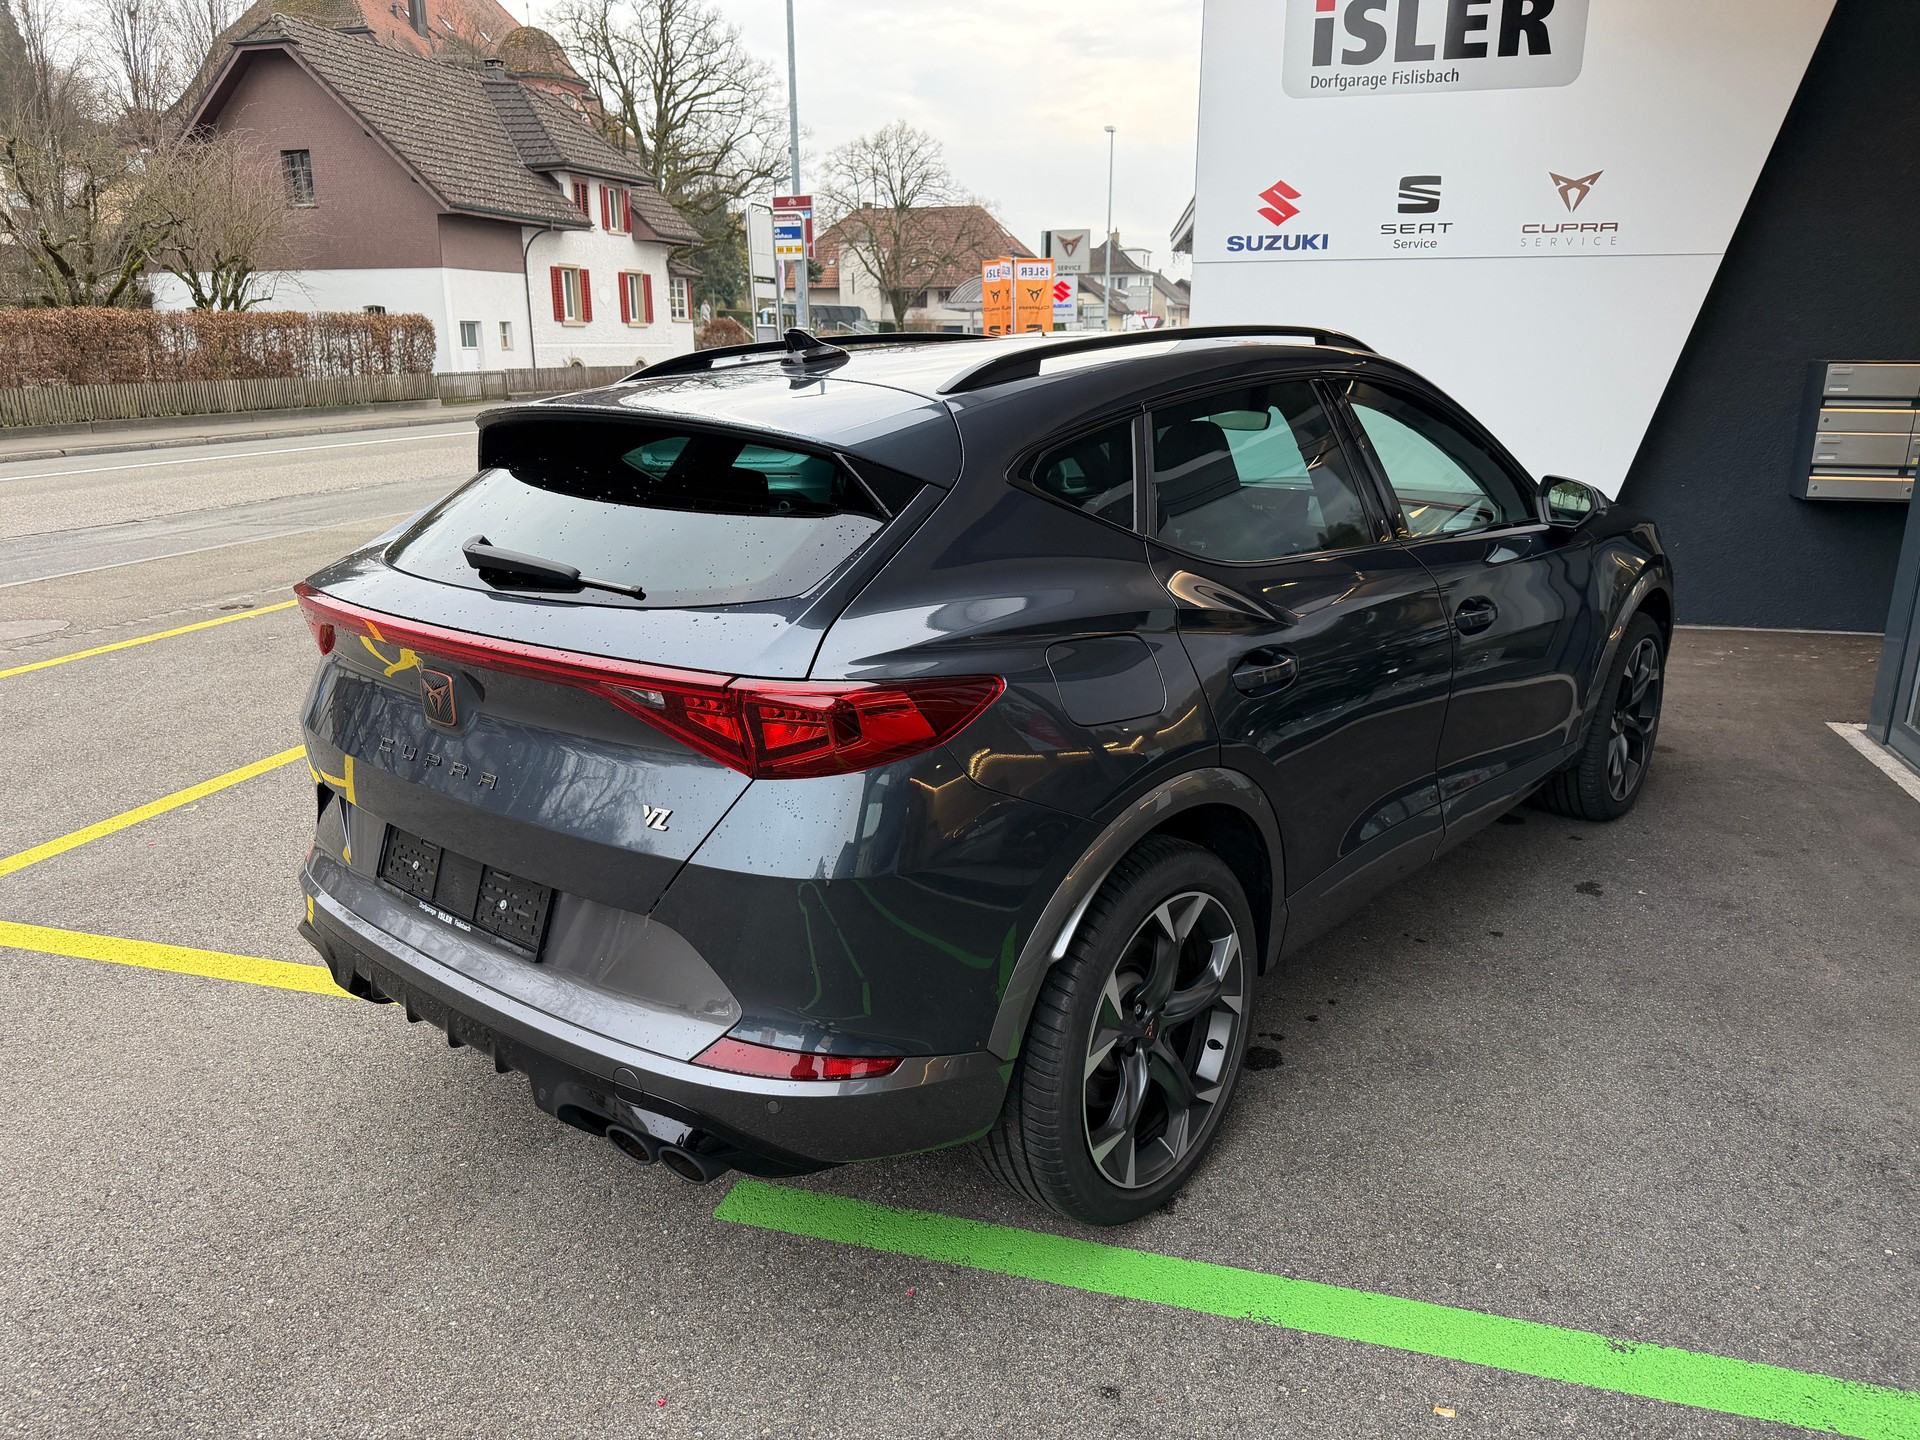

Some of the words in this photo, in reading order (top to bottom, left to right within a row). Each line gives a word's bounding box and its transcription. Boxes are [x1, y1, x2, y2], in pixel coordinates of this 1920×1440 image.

[1310, 74, 1387, 92] Dorfgarage
[1392, 68, 1460, 86] Fislisbach
[1380, 222, 1454, 235] SEAT
[1521, 222, 1619, 234] CUPRA
[1226, 233, 1329, 252] SUZUKI
[1393, 238, 1438, 250] Service
[1520, 235, 1618, 248] SERVICE
[1057, 264, 1082, 272] SERVICE
[379, 736, 499, 791] CUPRA
